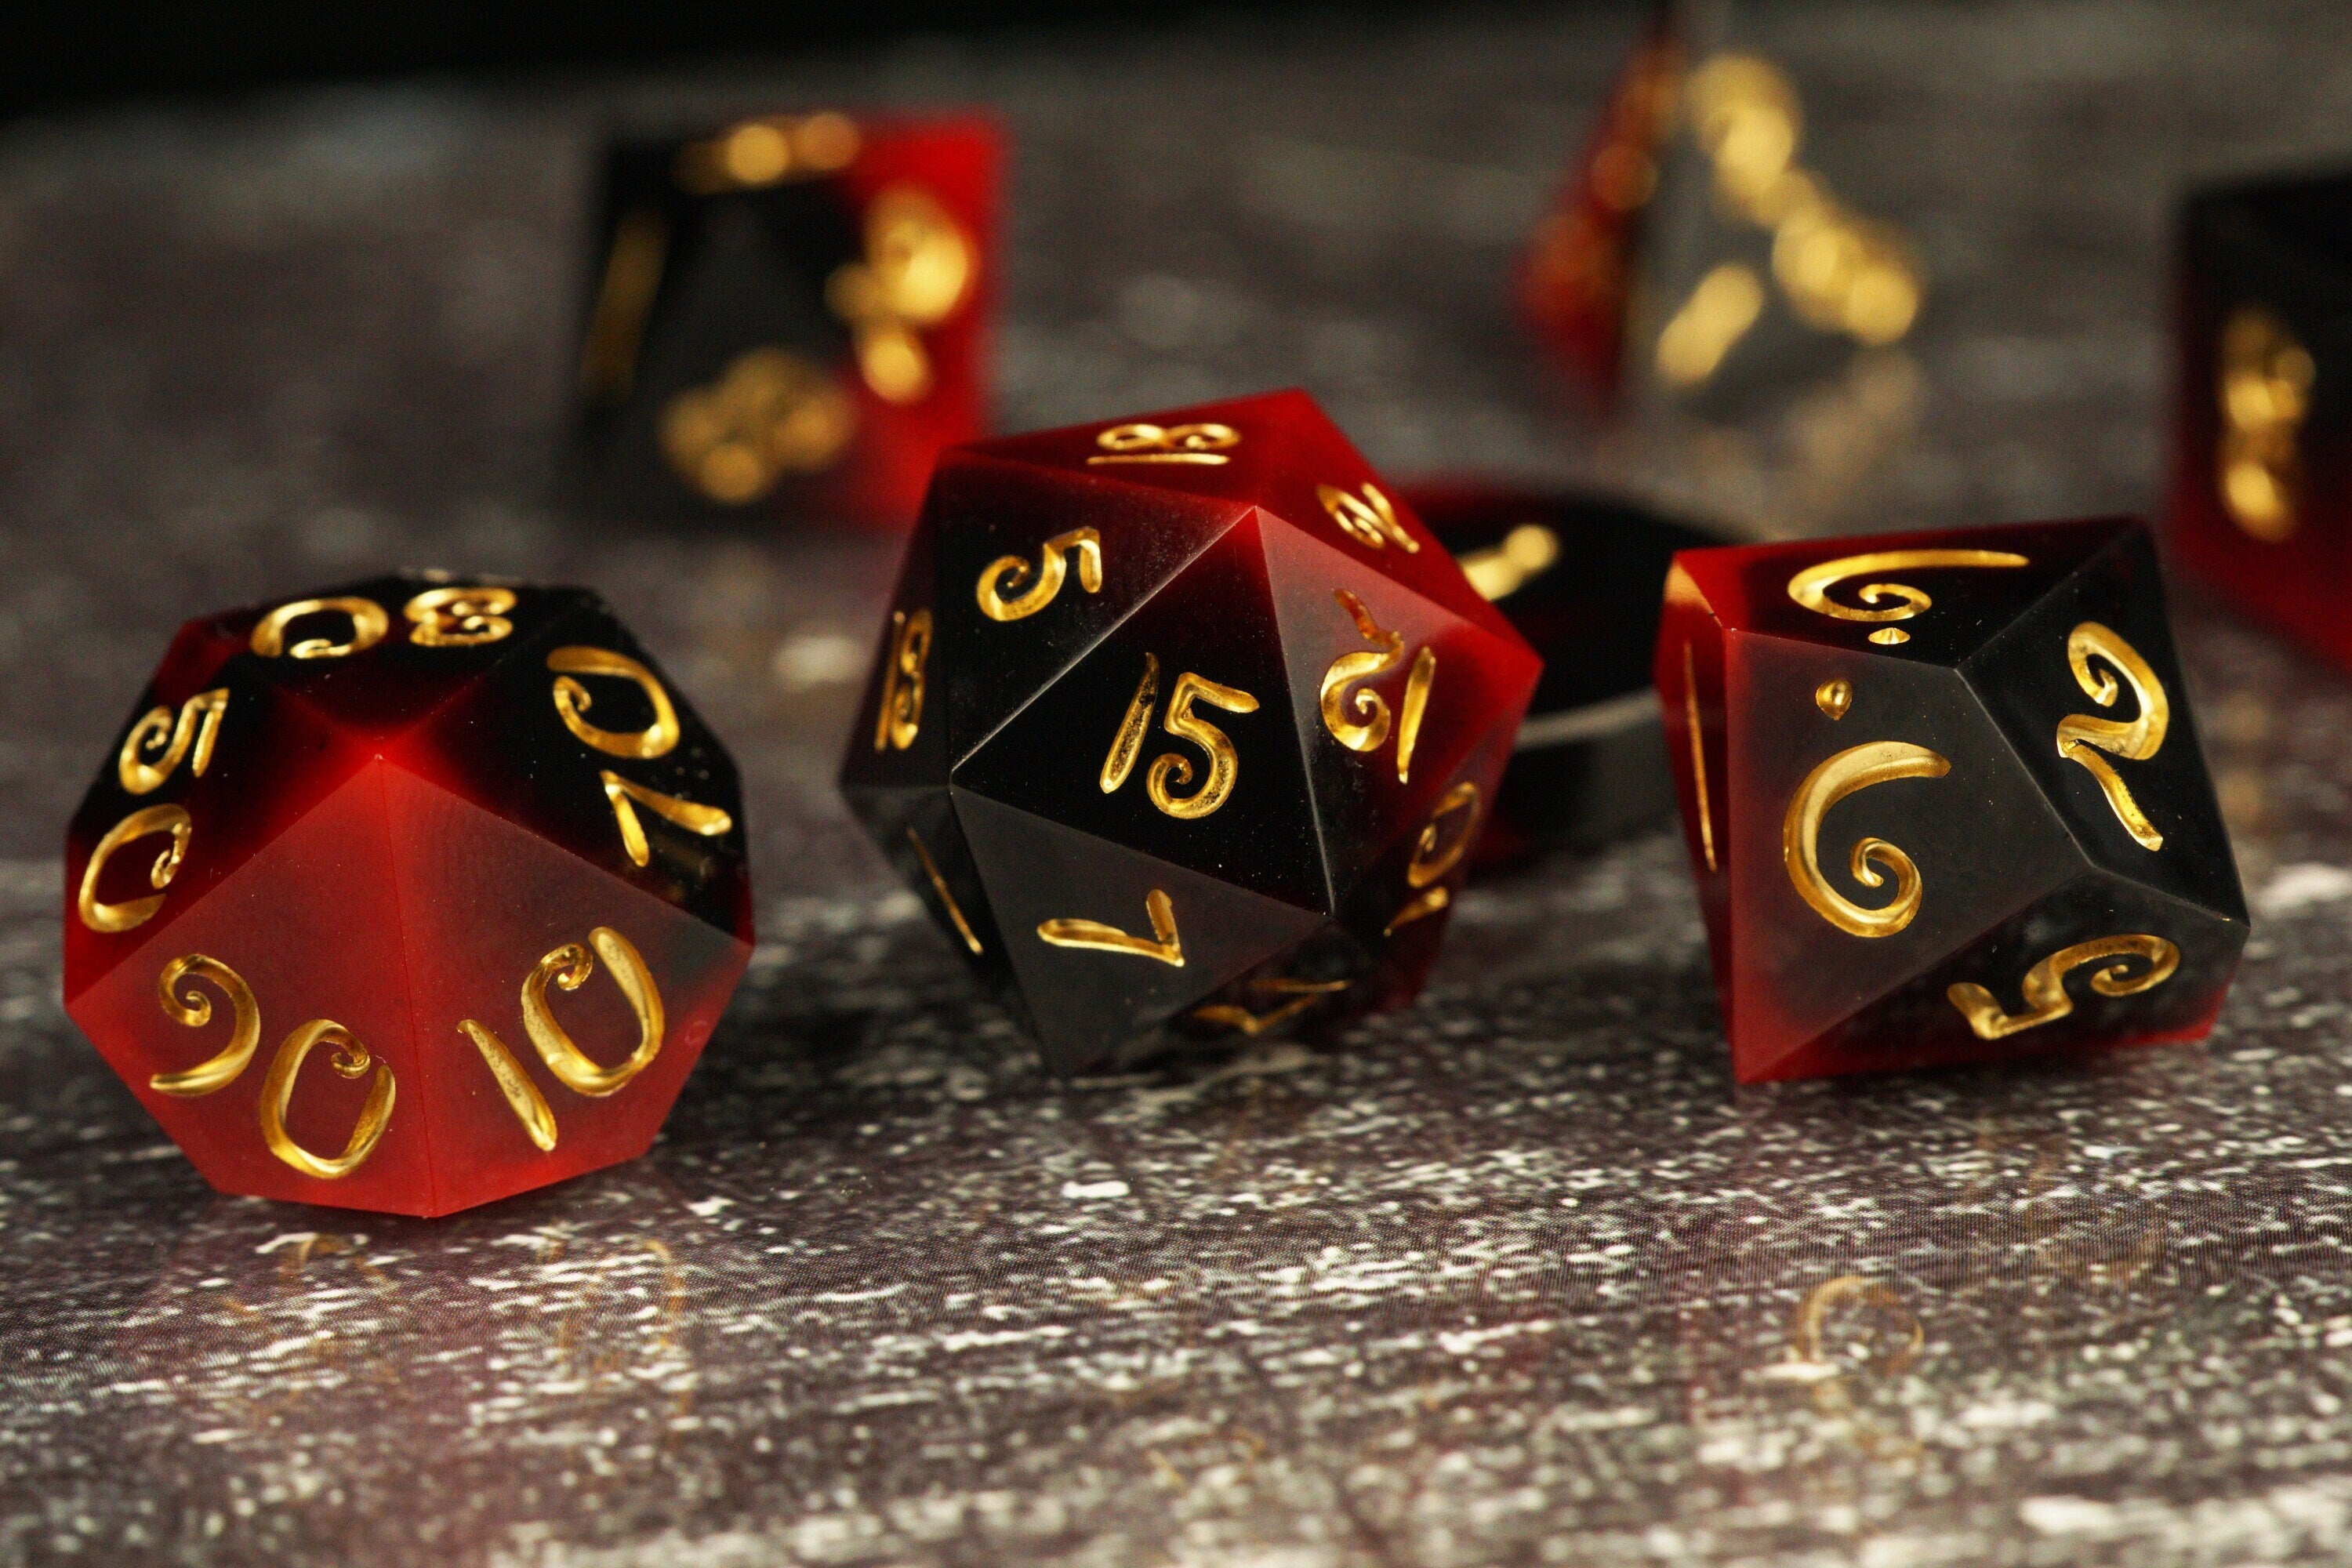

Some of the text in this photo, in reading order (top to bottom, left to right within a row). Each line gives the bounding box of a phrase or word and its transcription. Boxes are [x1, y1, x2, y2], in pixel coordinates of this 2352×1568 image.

[976, 526, 1103, 622] 5
[78, 688, 230, 934] 50
[1099, 652, 1260, 819] 15
[2056, 622, 2170, 851] 2
[1036, 888, 1186, 967] 7
[1947, 934, 2181, 1040] 5
[150, 953, 396, 1180] 90
[457, 927, 666, 1152] 10
